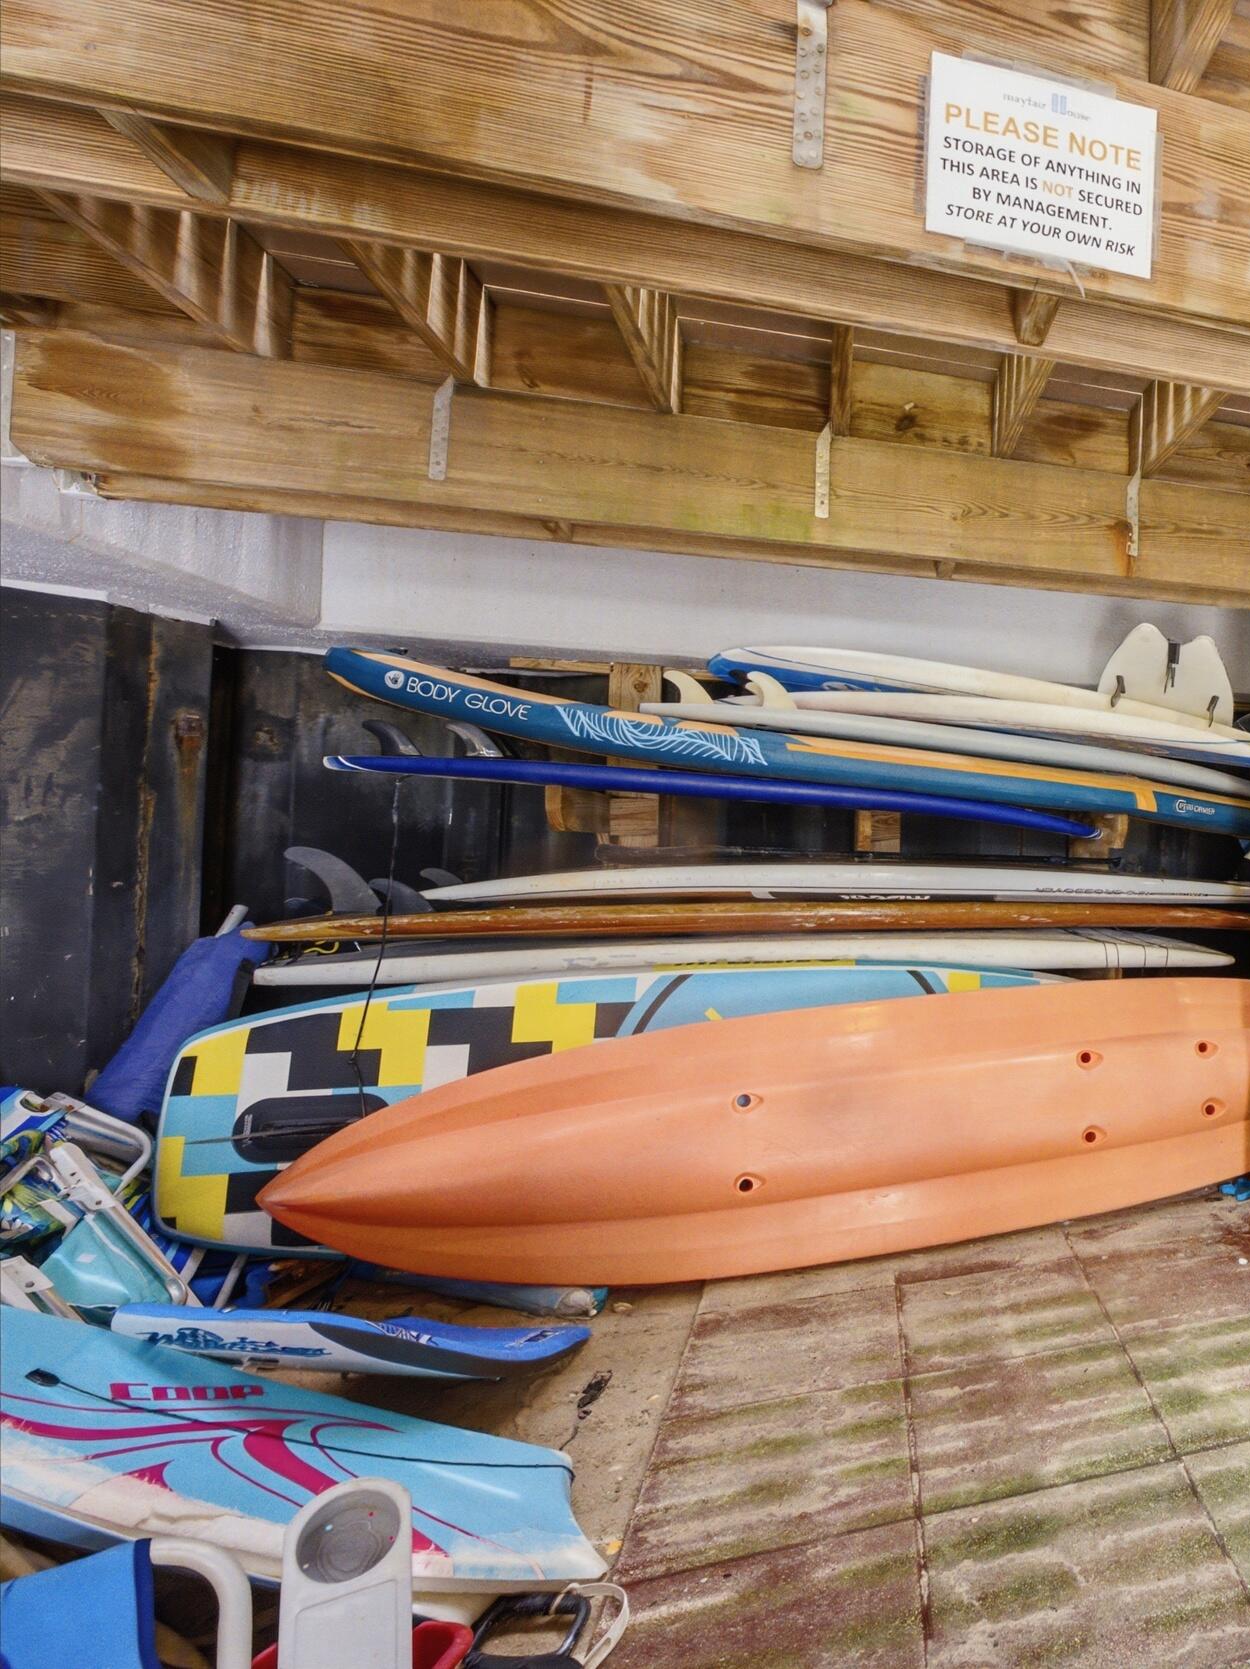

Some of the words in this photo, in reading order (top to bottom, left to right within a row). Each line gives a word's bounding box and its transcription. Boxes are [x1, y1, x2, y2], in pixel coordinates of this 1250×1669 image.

[944, 102, 1059, 149] PLEASE
[1068, 131, 1142, 171] NOTE
[940, 157, 975, 176] THIS
[979, 166, 1020, 187] AREA
[1025, 176, 1038, 190] IS
[1042, 180, 1073, 198] NOT
[1078, 189, 1143, 216] SECURED
[943, 135, 1016, 163] STORAGE
[1021, 152, 1041, 168] OF
[1045, 159, 1122, 190] ANYTHING
[1126, 180, 1141, 195] IN
[945, 203, 994, 225] STORE
[997, 214, 1017, 229] AT
[1021, 219, 1061, 239] YOUR
[1065, 230, 1101, 249] OWN
[1105, 238, 1136, 257] RISK
[972, 186, 991, 202] BY
[996, 192, 1113, 231] MANAGEMENT.
[406, 676, 461, 703] BODY
[464, 692, 532, 721] GLOVE
